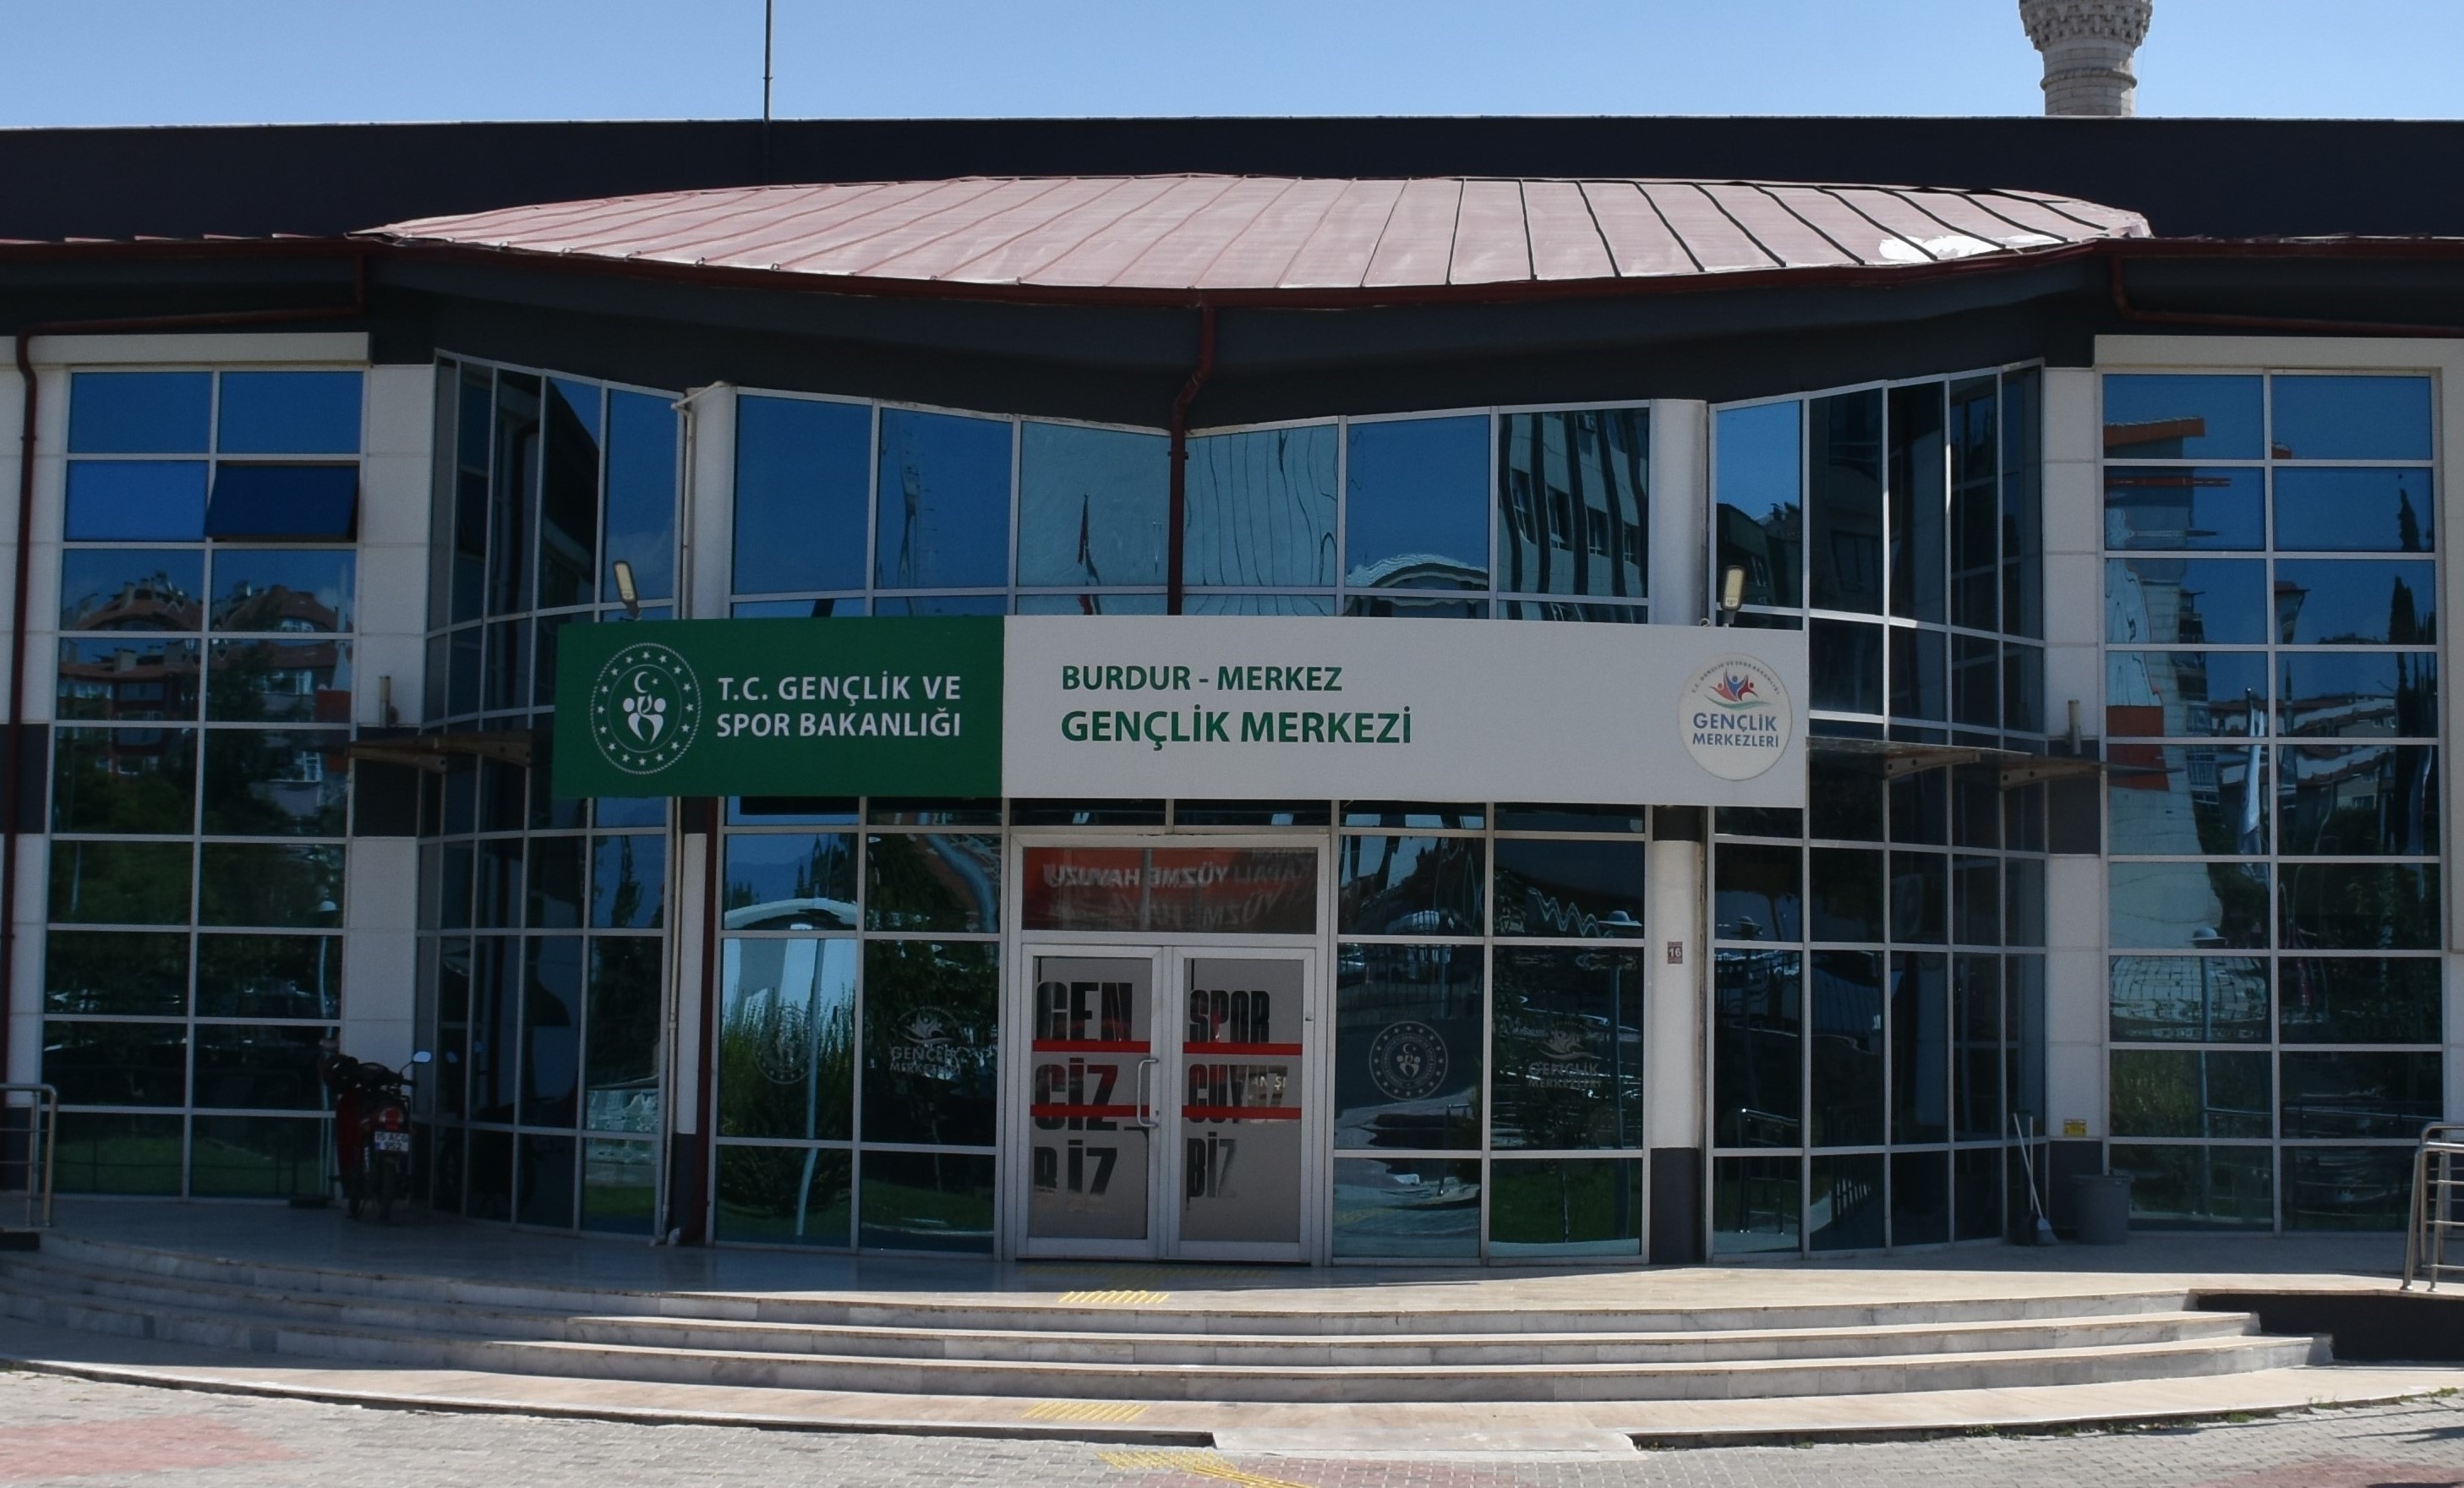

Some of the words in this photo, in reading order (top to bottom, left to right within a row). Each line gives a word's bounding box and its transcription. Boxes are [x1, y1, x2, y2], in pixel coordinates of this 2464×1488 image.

[718, 677, 768, 701] T.C.
[779, 670, 910, 707] GENÇLİK
[923, 676, 961, 700] VE
[1062, 665, 1191, 691] BURDUR
[1217, 666, 1342, 692] MERKEZ
[716, 713, 789, 737] SPOR
[800, 707, 960, 736] BAKANLIĞI
[1061, 703, 1230, 751] GENÇLİK
[1241, 706, 1411, 744] MERKEZİ
[1693, 713, 1777, 732] GENÇLİK
[1692, 733, 1778, 747] MERKEZLERİ
[1669, 947, 1681, 957] 16
[1189, 989, 1270, 1042] SPOR
[1187, 1132, 1237, 1199] BİZ
